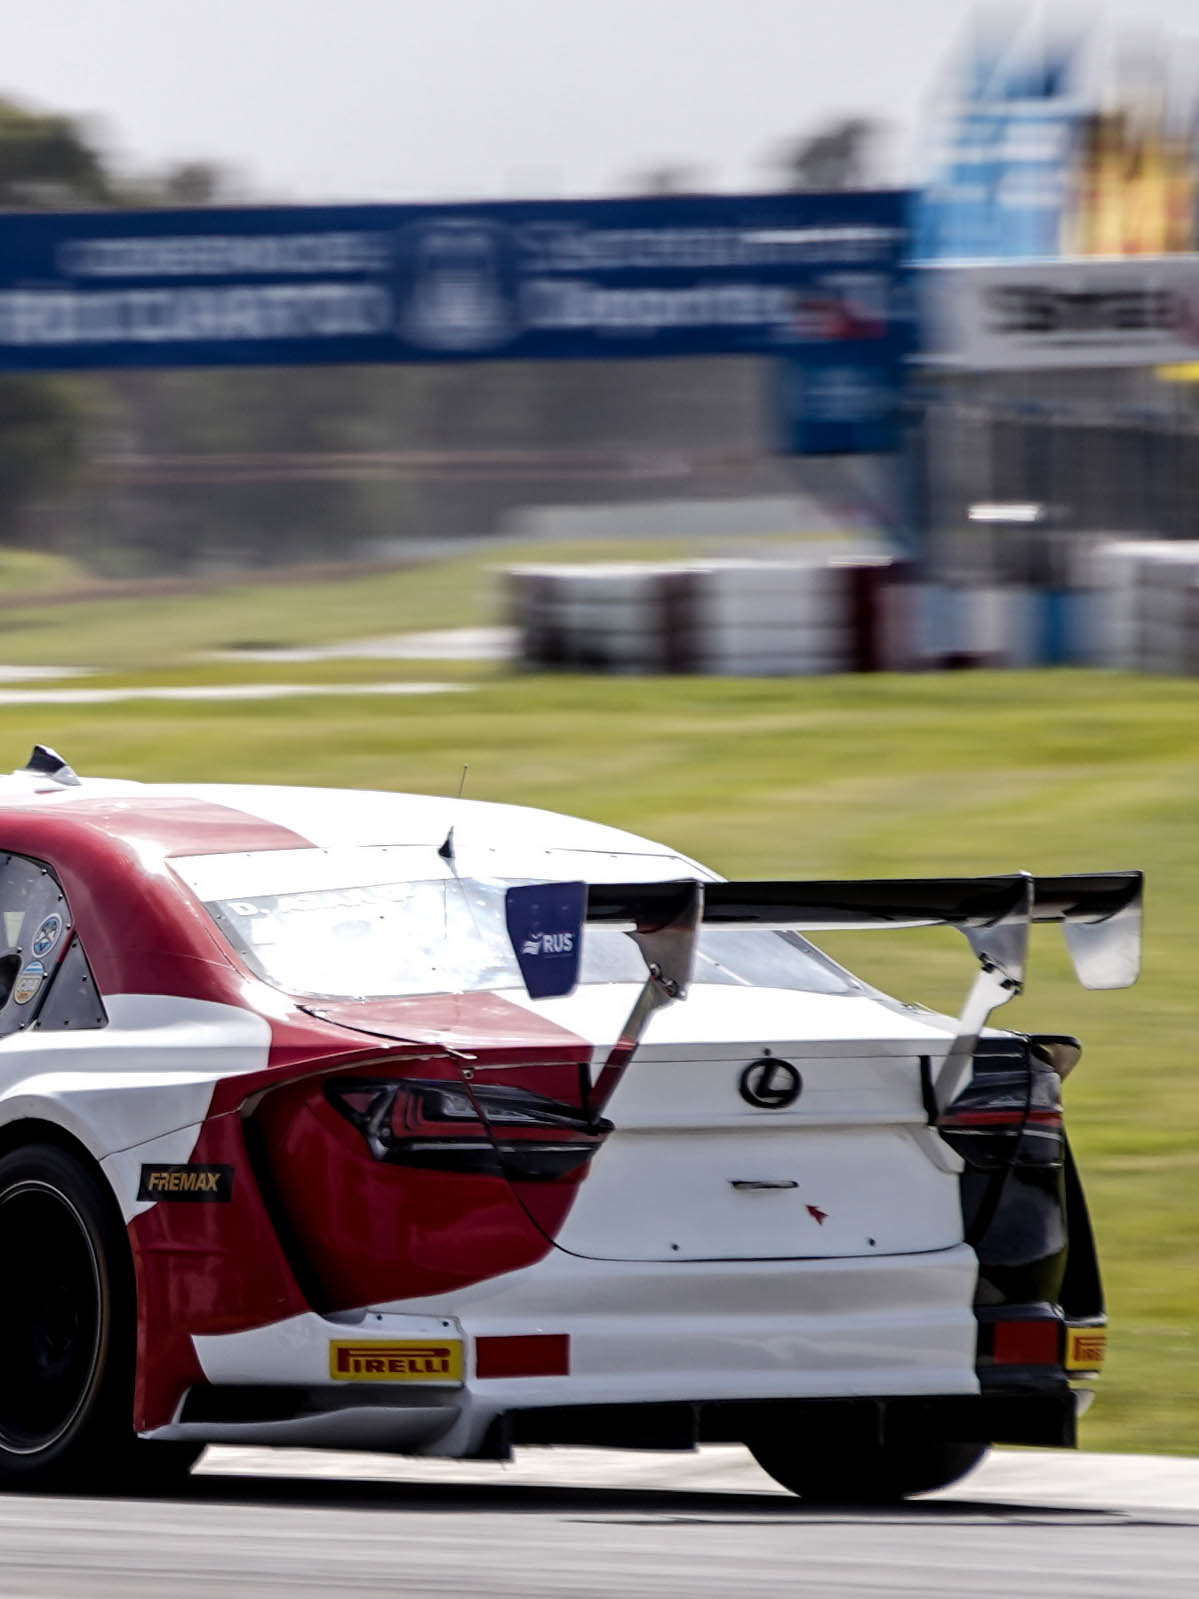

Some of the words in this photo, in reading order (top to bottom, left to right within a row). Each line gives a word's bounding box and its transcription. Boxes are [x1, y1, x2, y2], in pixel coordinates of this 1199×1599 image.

[543, 932, 574, 953] RUS
[147, 1171, 222, 1192] FREMAX
[337, 1347, 451, 1373] PIRELLI
